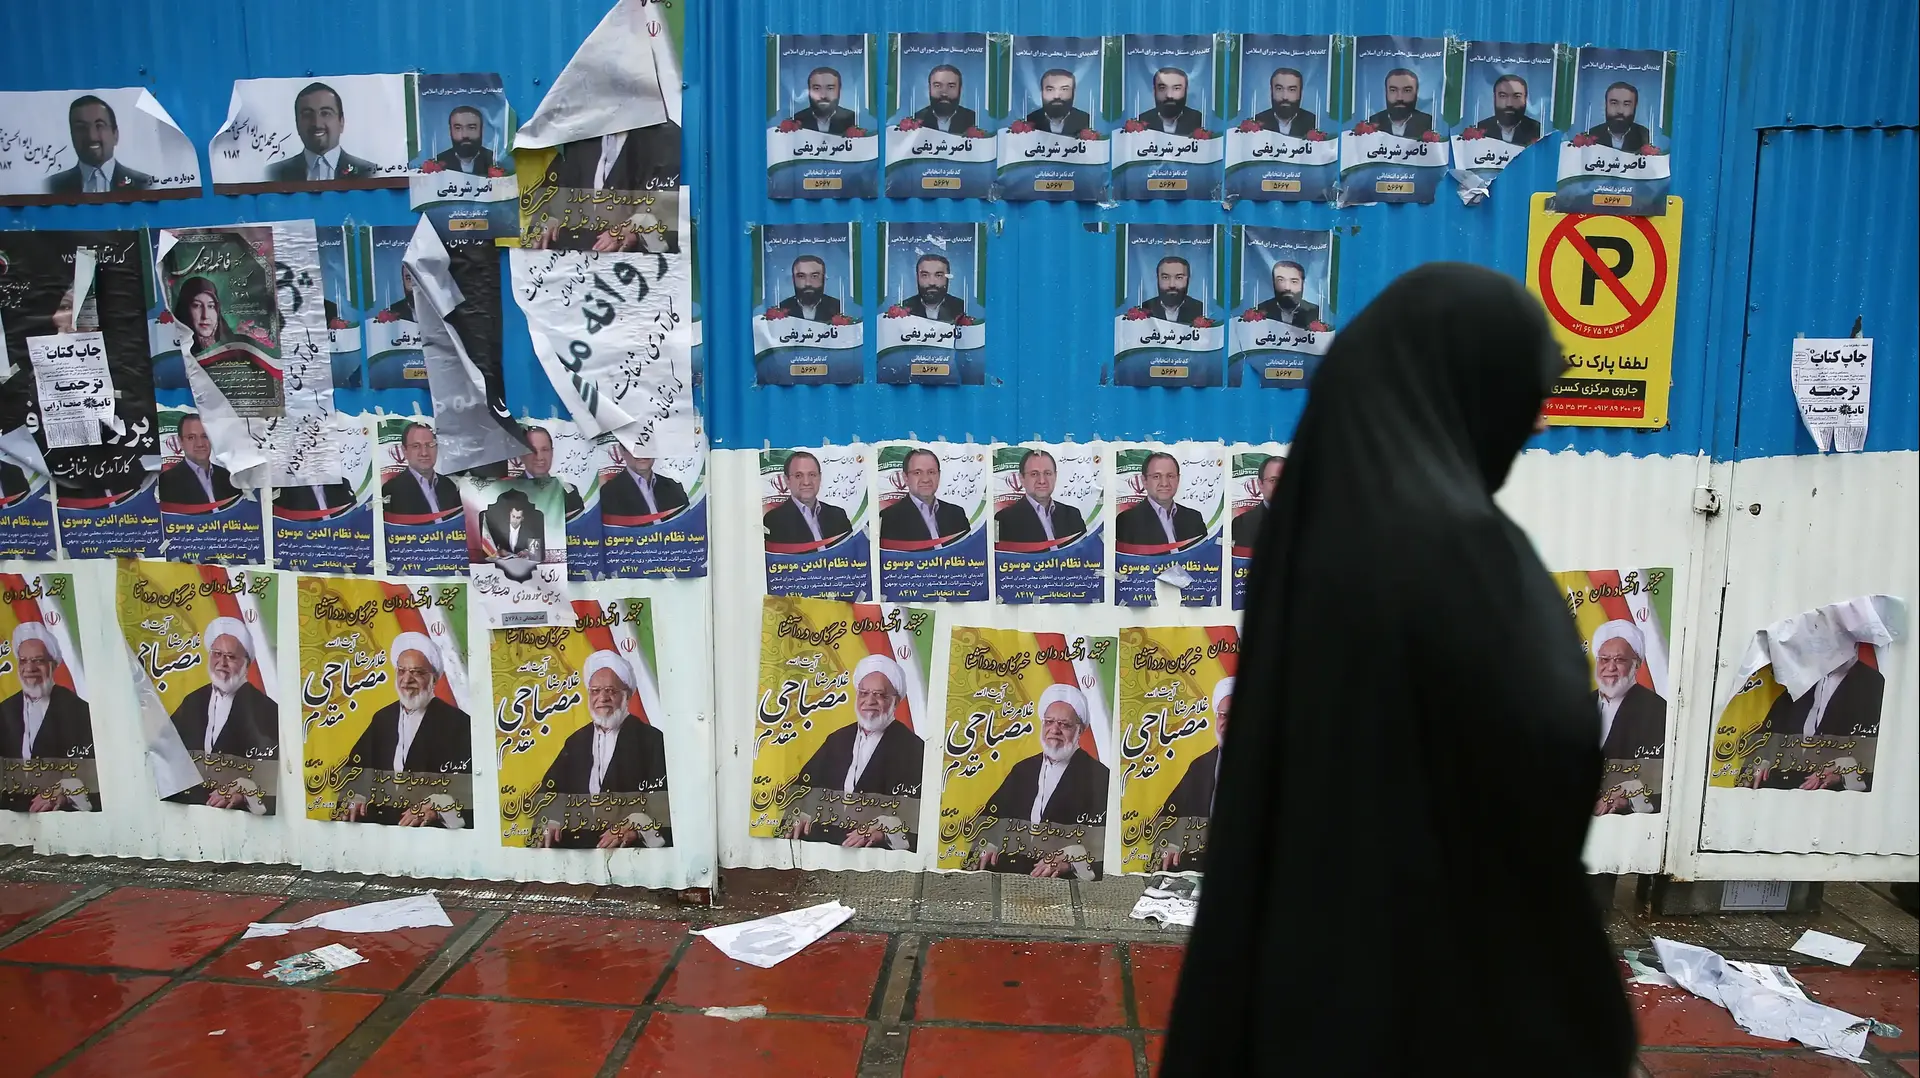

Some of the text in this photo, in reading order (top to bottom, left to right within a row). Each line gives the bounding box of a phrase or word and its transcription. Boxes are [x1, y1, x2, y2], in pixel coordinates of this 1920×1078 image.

[223, 149, 241, 159] ۱۱۸۲
[793, 140, 853, 156] ناصر شریفی
[912, 139, 973, 156] ناصر شریفی
[1024, 142, 1086, 158] ناصر شریفی
[1137, 141, 1199, 157] ناصر شریفی
[1252, 142, 1313, 158] ناصر شریفی
[1367, 143, 1428, 161] ناصر شریفی
[1474, 150, 1510, 165] شریفی
[1584, 156, 1647, 172] ناصر شریفی
[174, 172, 195, 185] دوباره
[646, 174, 678, 192] کاندیدای
[814, 180, 831, 188] ۵۶۶۷
[437, 182, 473, 198] شریفی
[1580, 236, 1634, 306] P
[779, 327, 838, 343] ناصر شریفی
[900, 327, 936, 343] شریفی
[1140, 329, 1200, 344] ناصر شریفی
[1255, 330, 1316, 346] ناصر شریفی
[46, 343, 102, 362] چاپ کتاب
[1810, 348, 1867, 369] چاپ کتاب
[1586, 354, 1615, 375] پارک
[1618, 355, 1649, 370] لطفا
[1160, 368, 1177, 376] ۵۶۶۷
[54, 379, 104, 394] ترجمه
[1551, 382, 1638, 397] جاروی مرکزی کسری
[1809, 384, 1860, 401] ترجمه
[635, 419, 655, 448] ۷۵۹۶
[167, 519, 259, 535] سید نظام الدین موسوی
[604, 530, 704, 547] سید نظام الدین موسوی
[883, 555, 985, 571] سید نظام الدین موسوی
[1000, 557, 1100, 573] سید نظام الدین موسوی
[898, 589, 918, 597] ۸۴۱۷
[355, 650, 387, 671] غلامرضا
[303, 660, 389, 711] مصباحی
[497, 684, 582, 736] مصباحی
[758, 679, 848, 730] مصباحی
[303, 703, 345, 743] مقدم
[1850, 721, 1879, 738] کاندیدای
[753, 721, 798, 760] مقدم
[946, 710, 1034, 762] مصباحی
[1122, 709, 1209, 760] مصباحی
[498, 729, 535, 769] مقدم
[1634, 743, 1664, 760] کاندیدای
[440, 758, 470, 775] کاندیدای
[941, 753, 985, 793] مقدم
[372, 769, 391, 783] مبارز
[1120, 755, 1162, 795] مقدم
[430, 778, 450, 793] جامعه
[393, 796, 410, 808] حوزه
